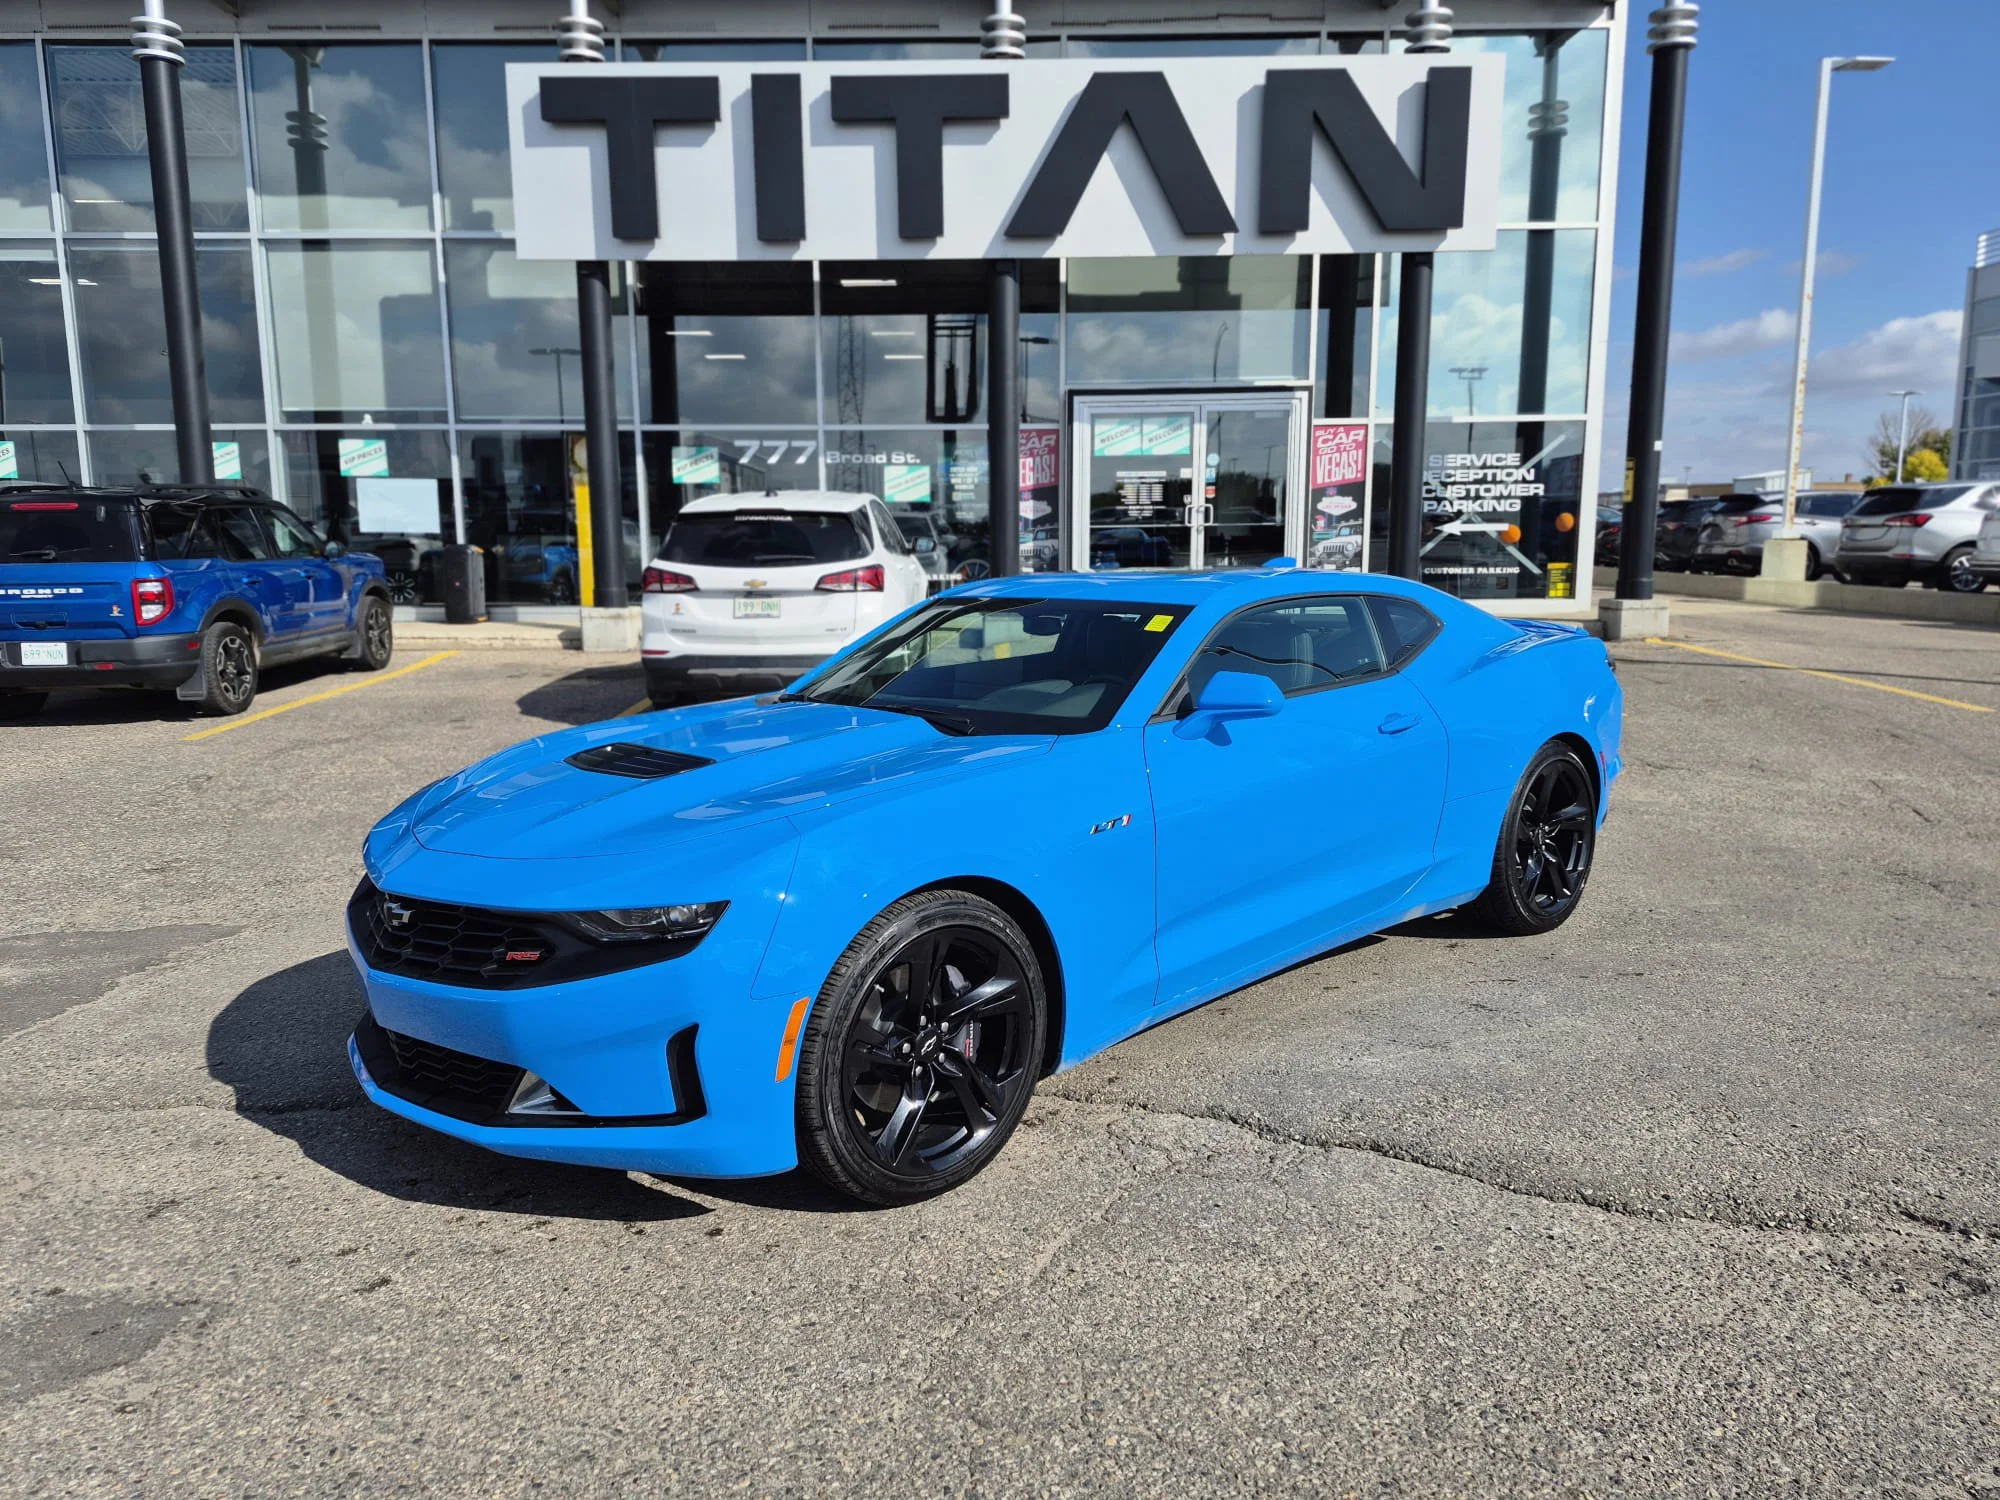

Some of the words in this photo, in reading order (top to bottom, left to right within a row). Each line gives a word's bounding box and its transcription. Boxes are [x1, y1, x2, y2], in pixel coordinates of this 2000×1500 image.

[538, 66, 1472, 242] TITAN
[1100, 424, 1135, 444] WELCOME
[1148, 423, 1184, 444] WELCOME
[1315, 428, 1336, 437] BUY
[1317, 429, 1365, 448] CAR
[0, 448, 9, 457] ES
[734, 440, 817, 464] 777
[826, 451, 887, 464] Broad
[891, 452, 921, 464] St.
[1319, 446, 1337, 455] GO
[1339, 443, 1355, 452] TO
[1316, 449, 1362, 484] VEGAS!
[1429, 453, 1520, 467] SERVICE
[1019, 454, 1055, 487] EGAS!
[1422, 483, 1545, 498] CUSTOMER
[1423, 499, 1521, 513] PARKING
[506, 951, 541, 961] RS
